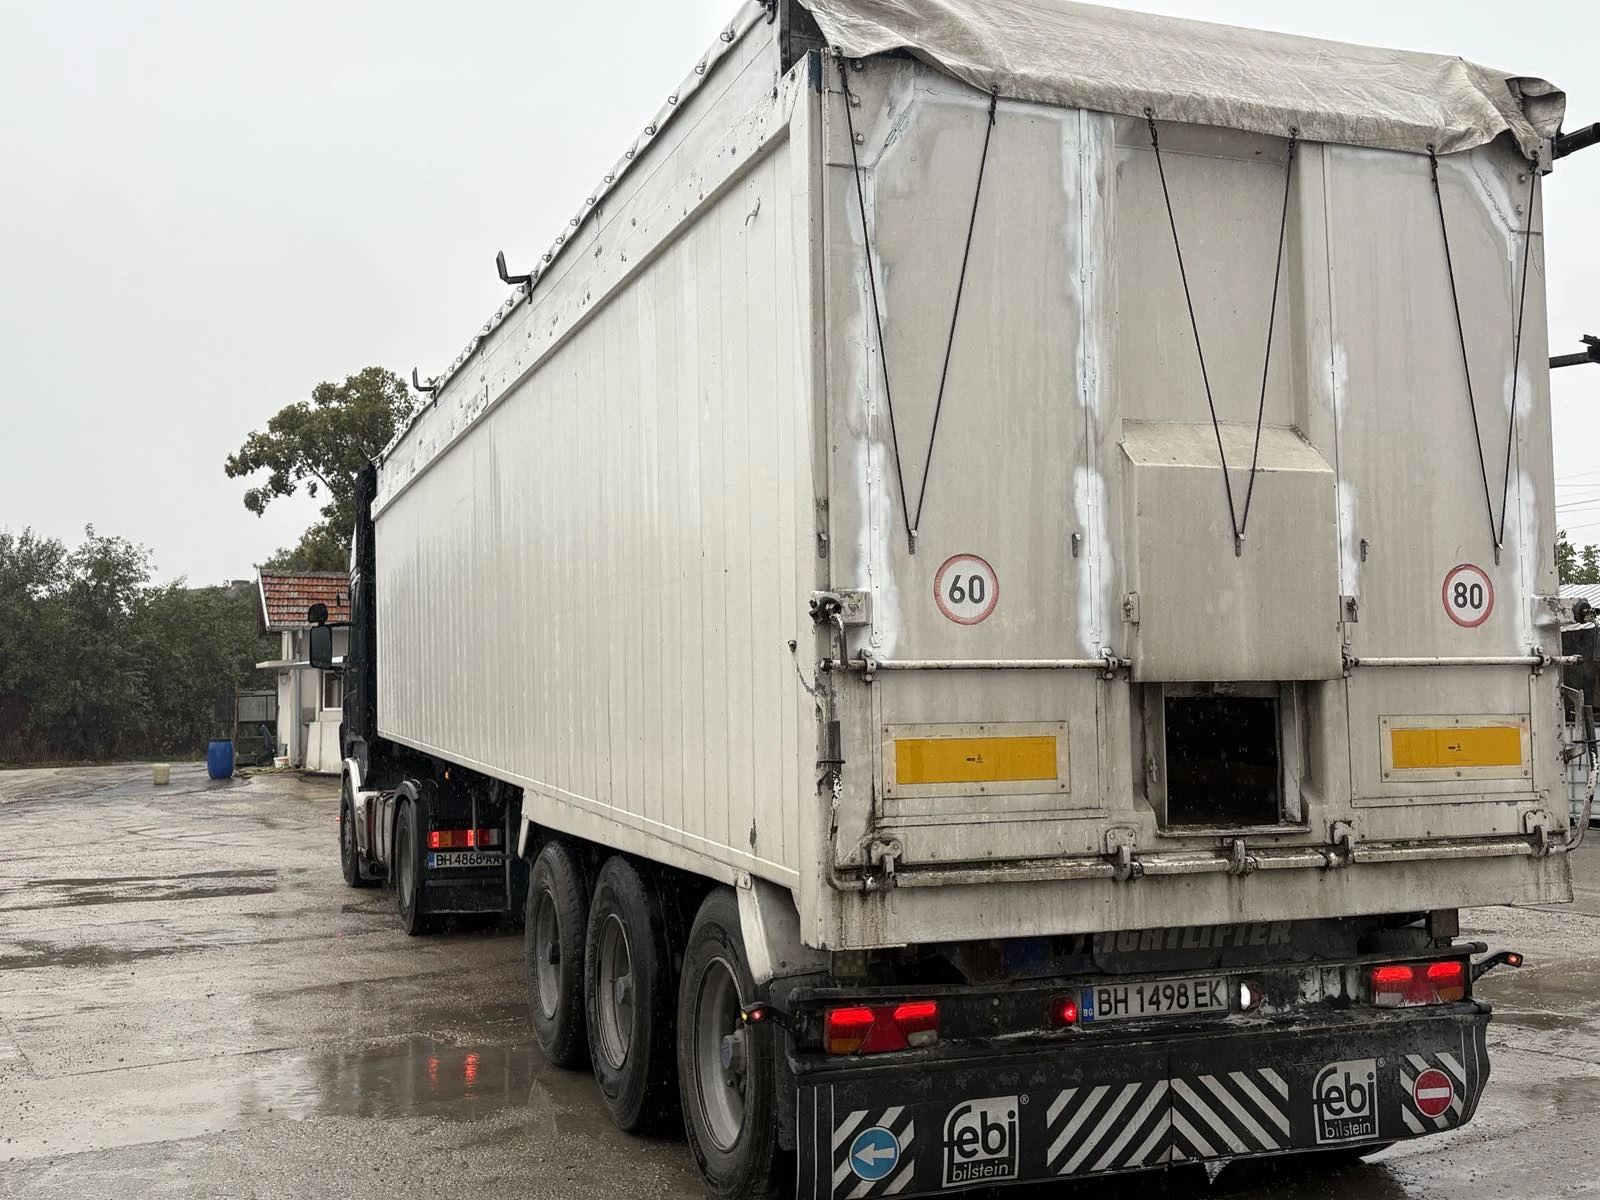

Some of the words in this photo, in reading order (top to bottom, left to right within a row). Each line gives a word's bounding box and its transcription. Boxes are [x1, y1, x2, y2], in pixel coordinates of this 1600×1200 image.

[949, 574, 985, 604] 60
[1454, 581, 1483, 610] 80
[436, 853, 452, 866] BH
[1098, 987, 1129, 1016] BH
[1136, 982, 1190, 1014] 1498
[1194, 979, 1224, 1009] EK
[1083, 1008, 1094, 1017] BG
[1314, 1066, 1375, 1118] febi
[944, 1104, 1017, 1161] febi
[1324, 1118, 1371, 1138] bilstein
[952, 1160, 1009, 1181] bilstein
